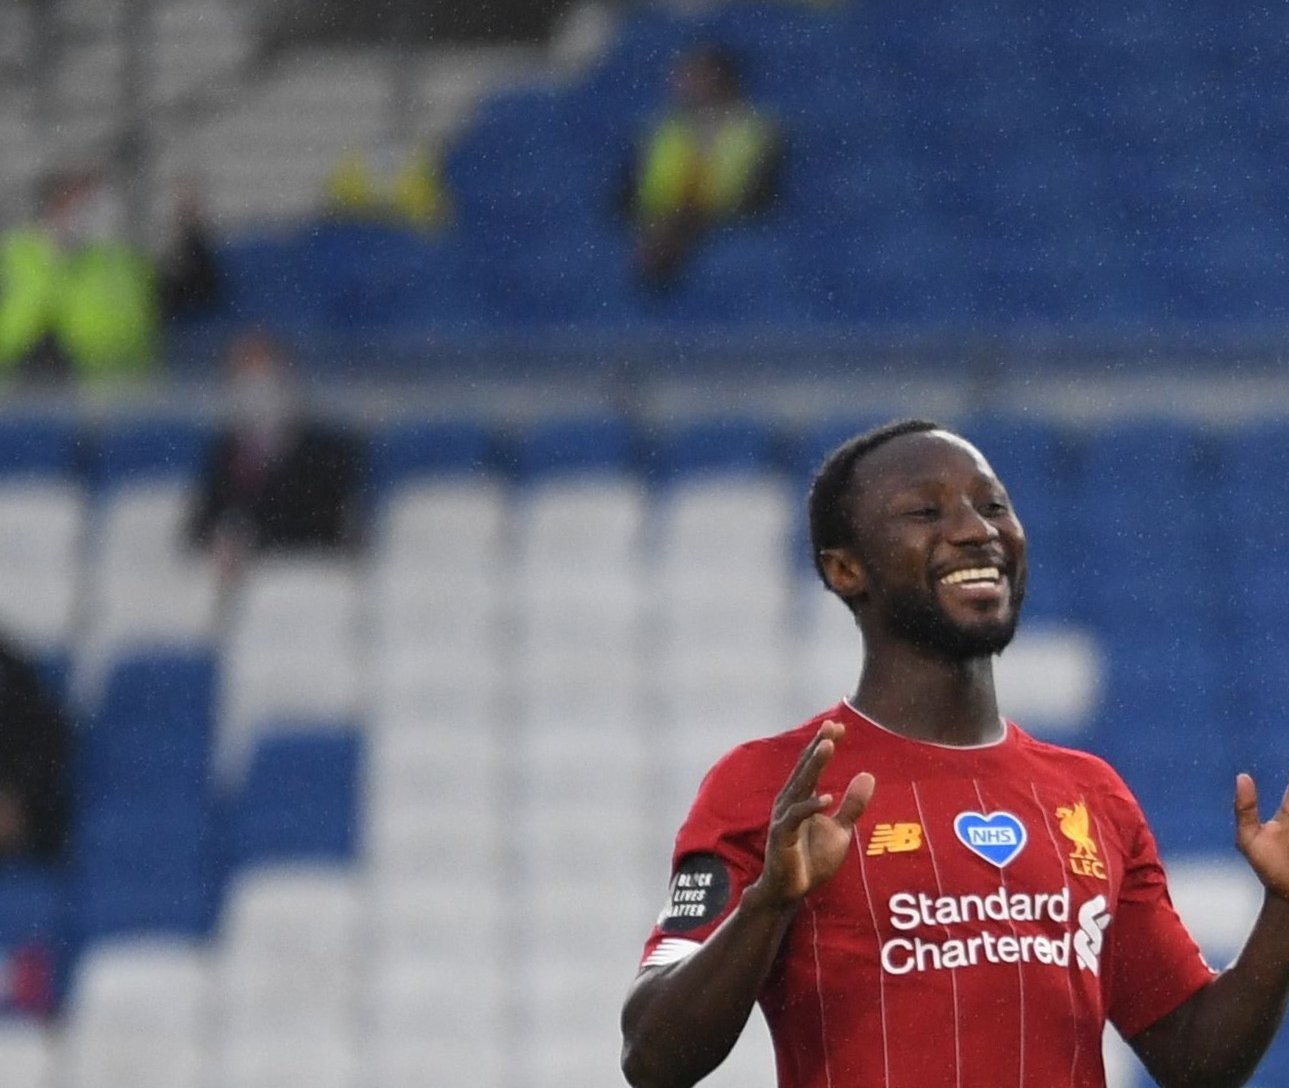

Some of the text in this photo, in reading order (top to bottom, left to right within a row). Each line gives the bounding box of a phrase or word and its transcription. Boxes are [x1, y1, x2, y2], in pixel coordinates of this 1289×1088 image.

[971, 828, 1012, 845] NHS
[673, 888, 706, 902] LIVES
[888, 886, 1071, 930] Standard
[881, 931, 1072, 975] Chartered
